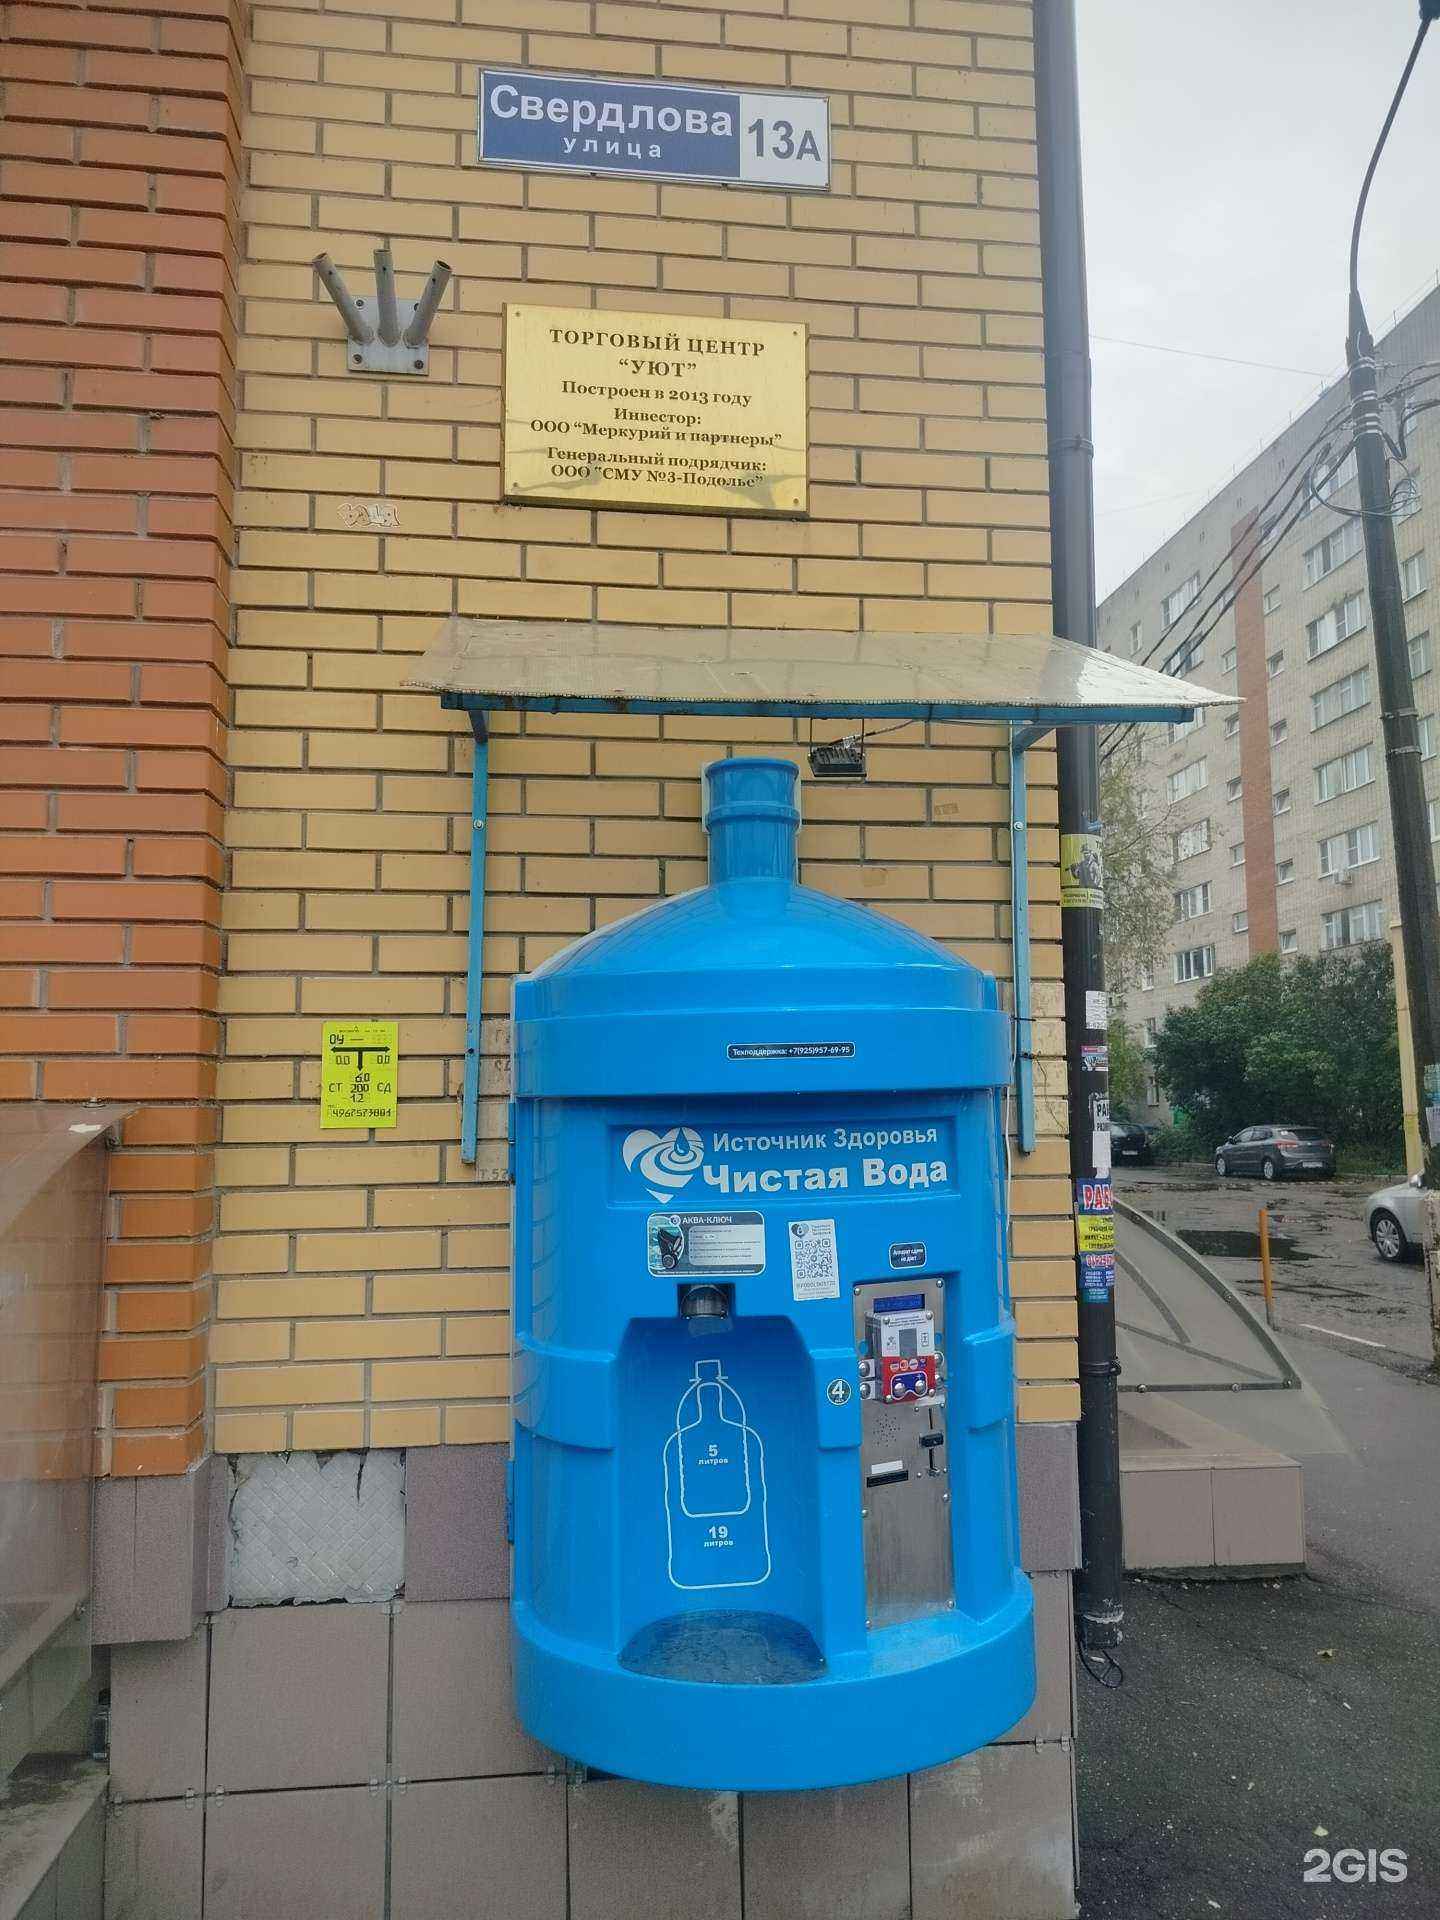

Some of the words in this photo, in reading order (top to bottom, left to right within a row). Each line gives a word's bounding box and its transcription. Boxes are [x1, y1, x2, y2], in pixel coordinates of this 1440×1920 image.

[490, 84, 733, 137] Свердлова
[562, 136, 662, 159] улица
[747, 117, 822, 162] 13А
[549, 328, 681, 352] ТОРГОВЫЙ
[687, 338, 765, 357] ЦЕНТР
[618, 358, 697, 378] “УЮТ”
[561, 381, 650, 400] Построен
[654, 389, 665, 400] в
[668, 389, 709, 405] 2013
[712, 393, 752, 407] году
[614, 407, 702, 426] Инвестор:
[530, 420, 570, 434] ООО
[574, 421, 671, 442] “Меркурий
[675, 431, 687, 441] и
[690, 432, 782, 447] партнеры”
[547, 447, 665, 465] Генеральный
[668, 457, 767, 472] подрядчик:
[551, 464, 591, 478] ООО
[594, 465, 642, 482] “СМУ
[646, 469, 764, 489] №3-Подолье”
[712, 1132, 827, 1153] Источник
[833, 1128, 938, 1151] Здоровья
[703, 1163, 849, 1194] Чистая
[861, 1157, 948, 1189] Вода
[682, 1215, 733, 1225] АКВА-КЛЮЧ
[831, 1380, 845, 1399] 4
[698, 1457, 728, 1466] литров
[708, 1444, 718, 1457] 5
[703, 1538, 734, 1548] литров
[708, 1526, 729, 1539] 19
